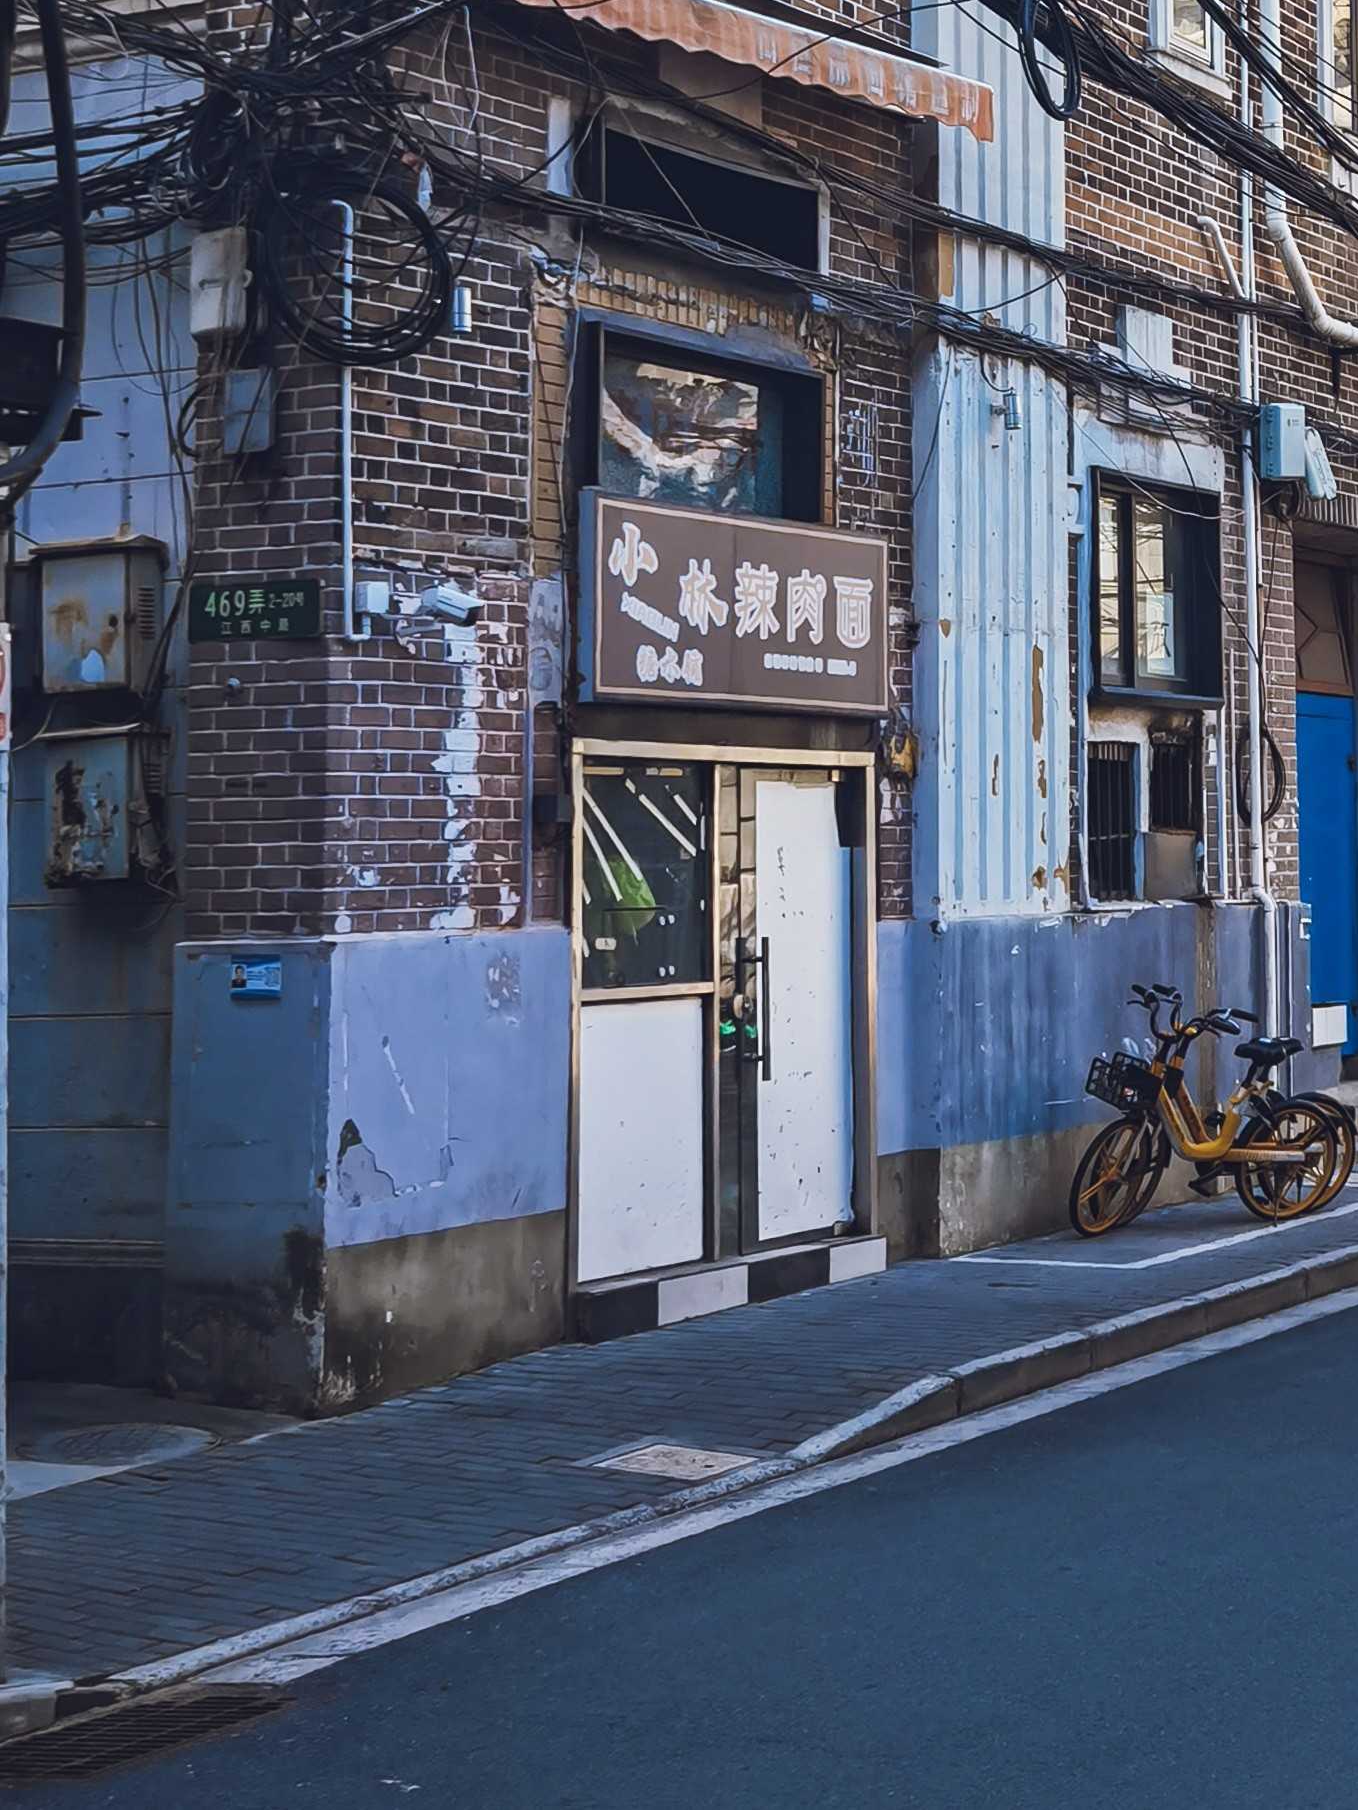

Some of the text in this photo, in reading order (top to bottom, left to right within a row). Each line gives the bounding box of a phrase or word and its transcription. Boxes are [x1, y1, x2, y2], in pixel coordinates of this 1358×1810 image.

[608, 522, 873, 648] 小林辣肉面
